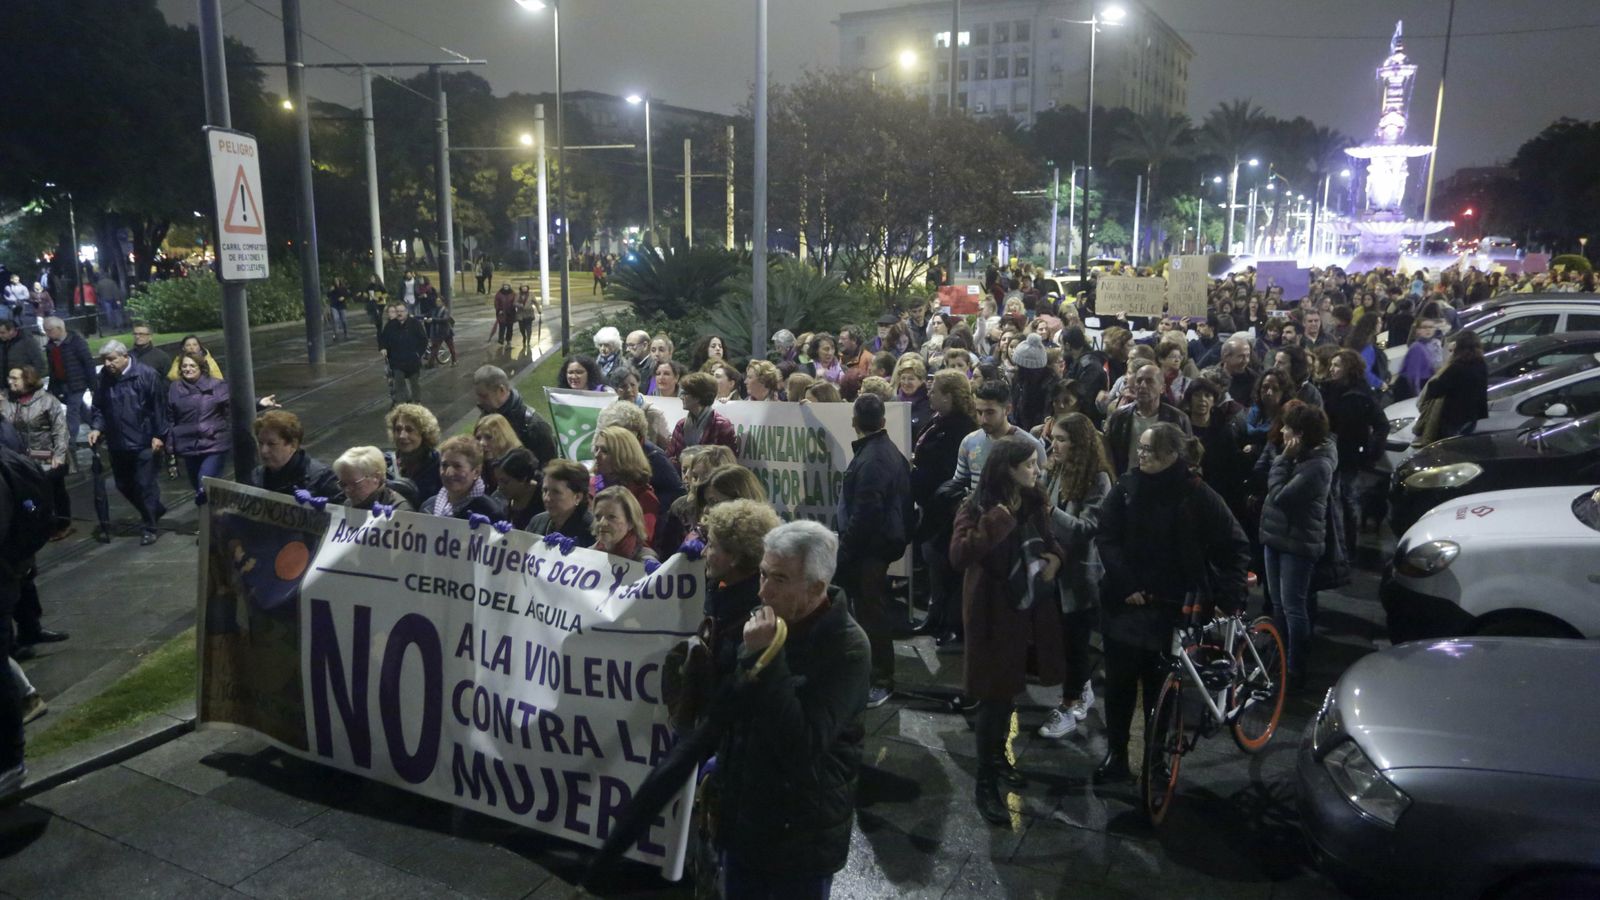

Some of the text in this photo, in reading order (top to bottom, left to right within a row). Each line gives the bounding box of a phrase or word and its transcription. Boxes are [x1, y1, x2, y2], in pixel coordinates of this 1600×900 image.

[218, 139, 254, 157] PELIGRO
[222, 243, 241, 251] CARRIL
[228, 253, 236, 261] DE
[772, 468, 801, 505] POR
[803, 470, 825, 506] LA
[331, 518, 427, 554] Asociación
[434, 529, 461, 559] de
[466, 533, 545, 578] Mujeres
[547, 560, 602, 591] OCIO
[618, 573, 697, 600] SALUD
[405, 573, 583, 635] CERRO DEL ÁGUILA
[310, 598, 443, 784] NO
[455, 622, 669, 705] A LA VIOLENC
[452, 679, 604, 758] CONTRA
[452, 742, 681, 857] MUJERE
